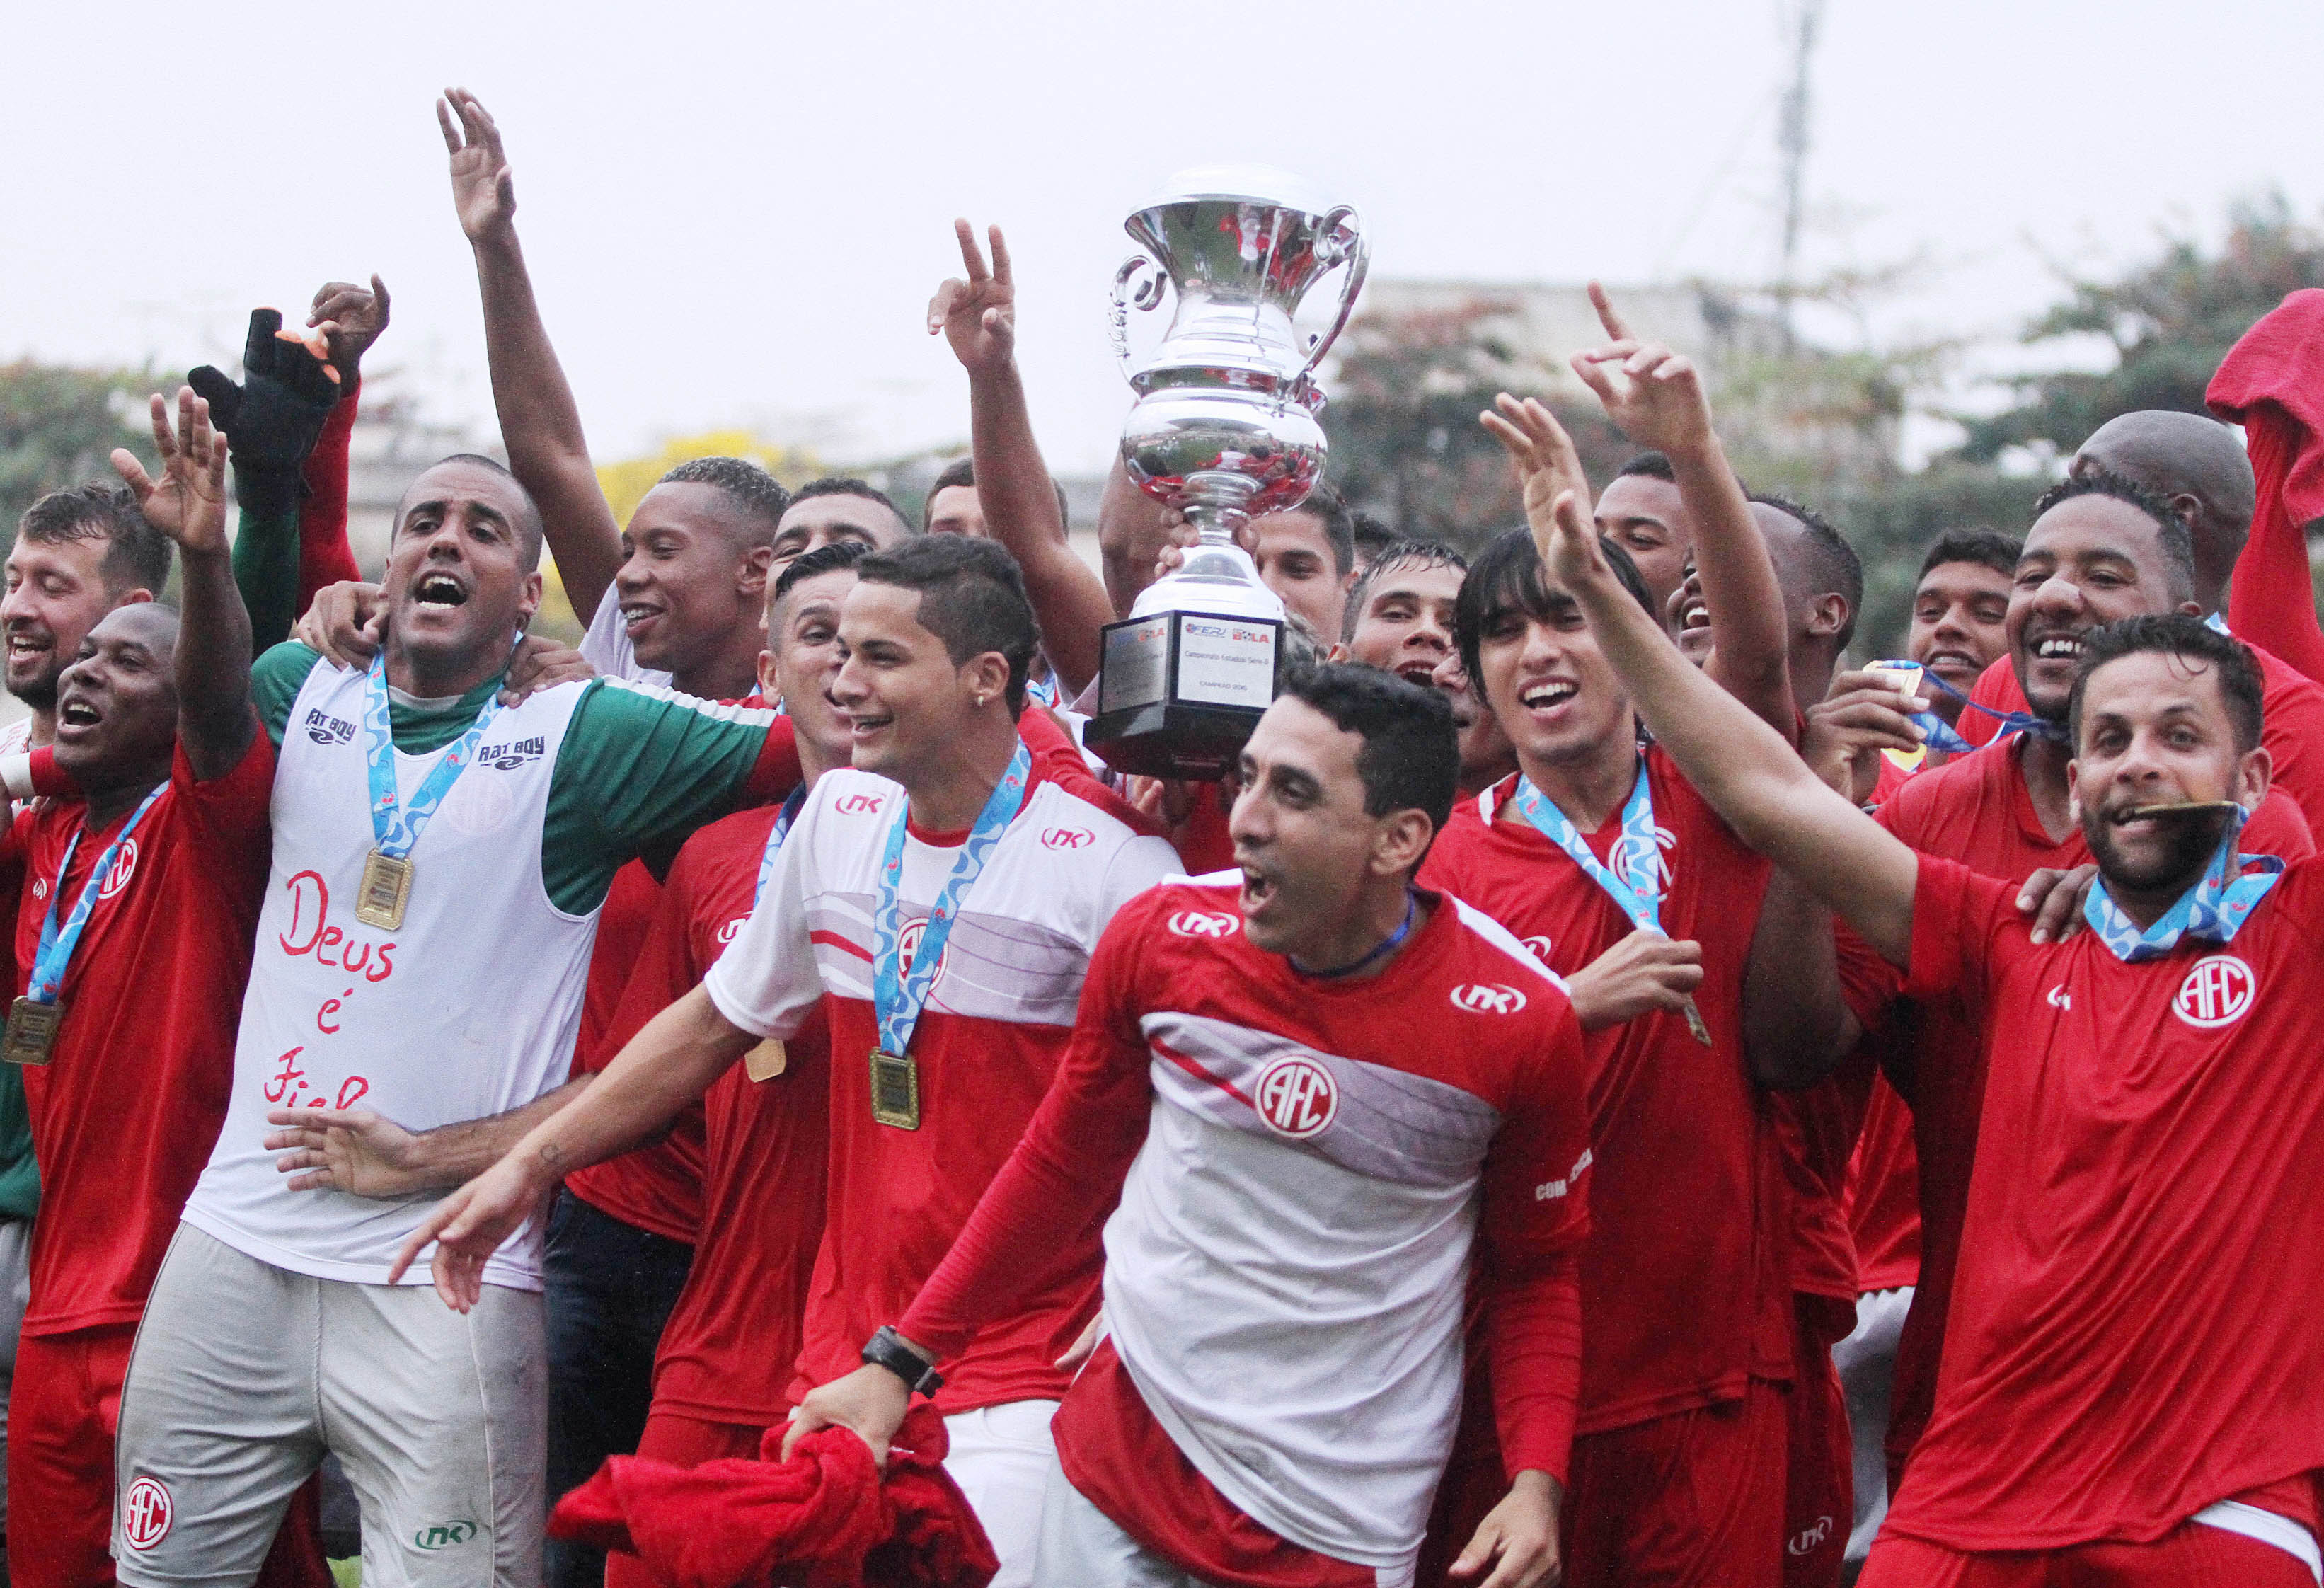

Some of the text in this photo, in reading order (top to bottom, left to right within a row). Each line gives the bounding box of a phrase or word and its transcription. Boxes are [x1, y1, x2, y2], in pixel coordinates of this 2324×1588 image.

[328, 717, 357, 742] BOY
[514, 736, 545, 754] BOY
[280, 870, 396, 982] Deus
[2178, 960, 2247, 1020] AFC
[1262, 1063, 1330, 1131] AFC
[126, 1483, 168, 1542] AFC
